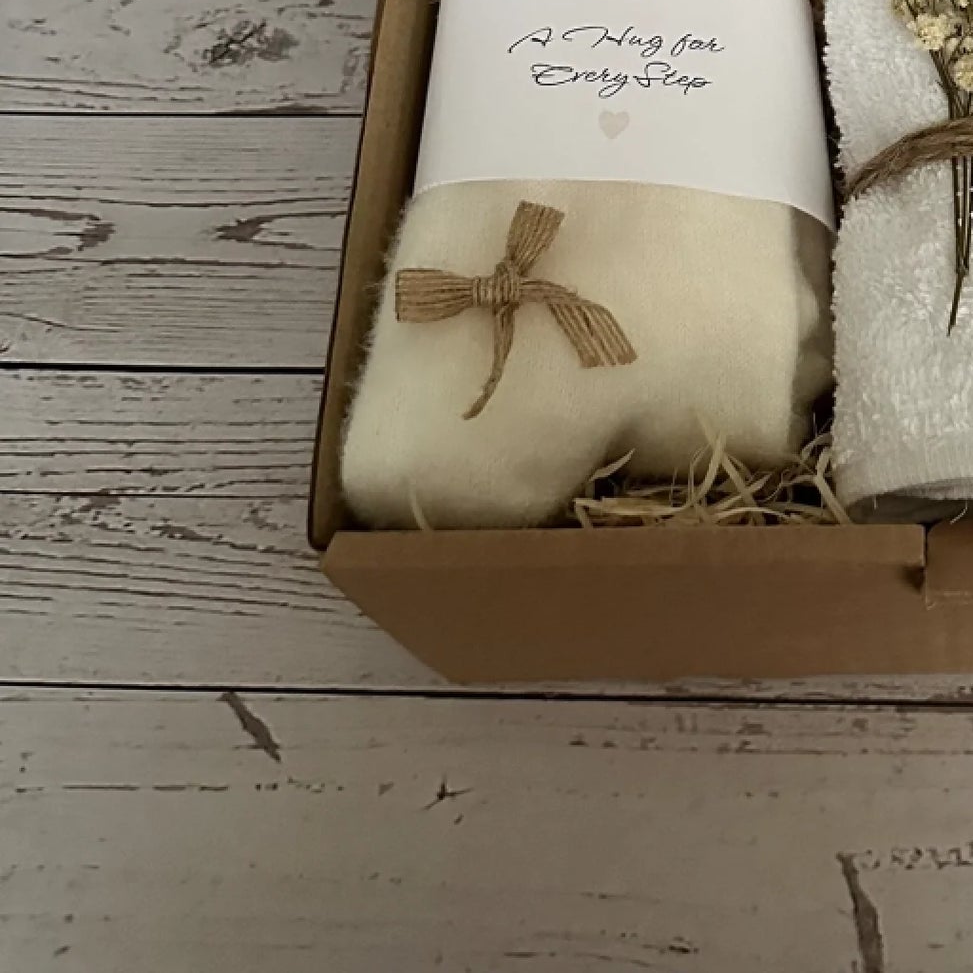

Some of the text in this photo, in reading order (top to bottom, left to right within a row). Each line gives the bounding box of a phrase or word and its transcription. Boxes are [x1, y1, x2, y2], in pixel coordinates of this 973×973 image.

[507, 26, 725, 57] A Hug for
[530, 61, 713, 99] Every Step
